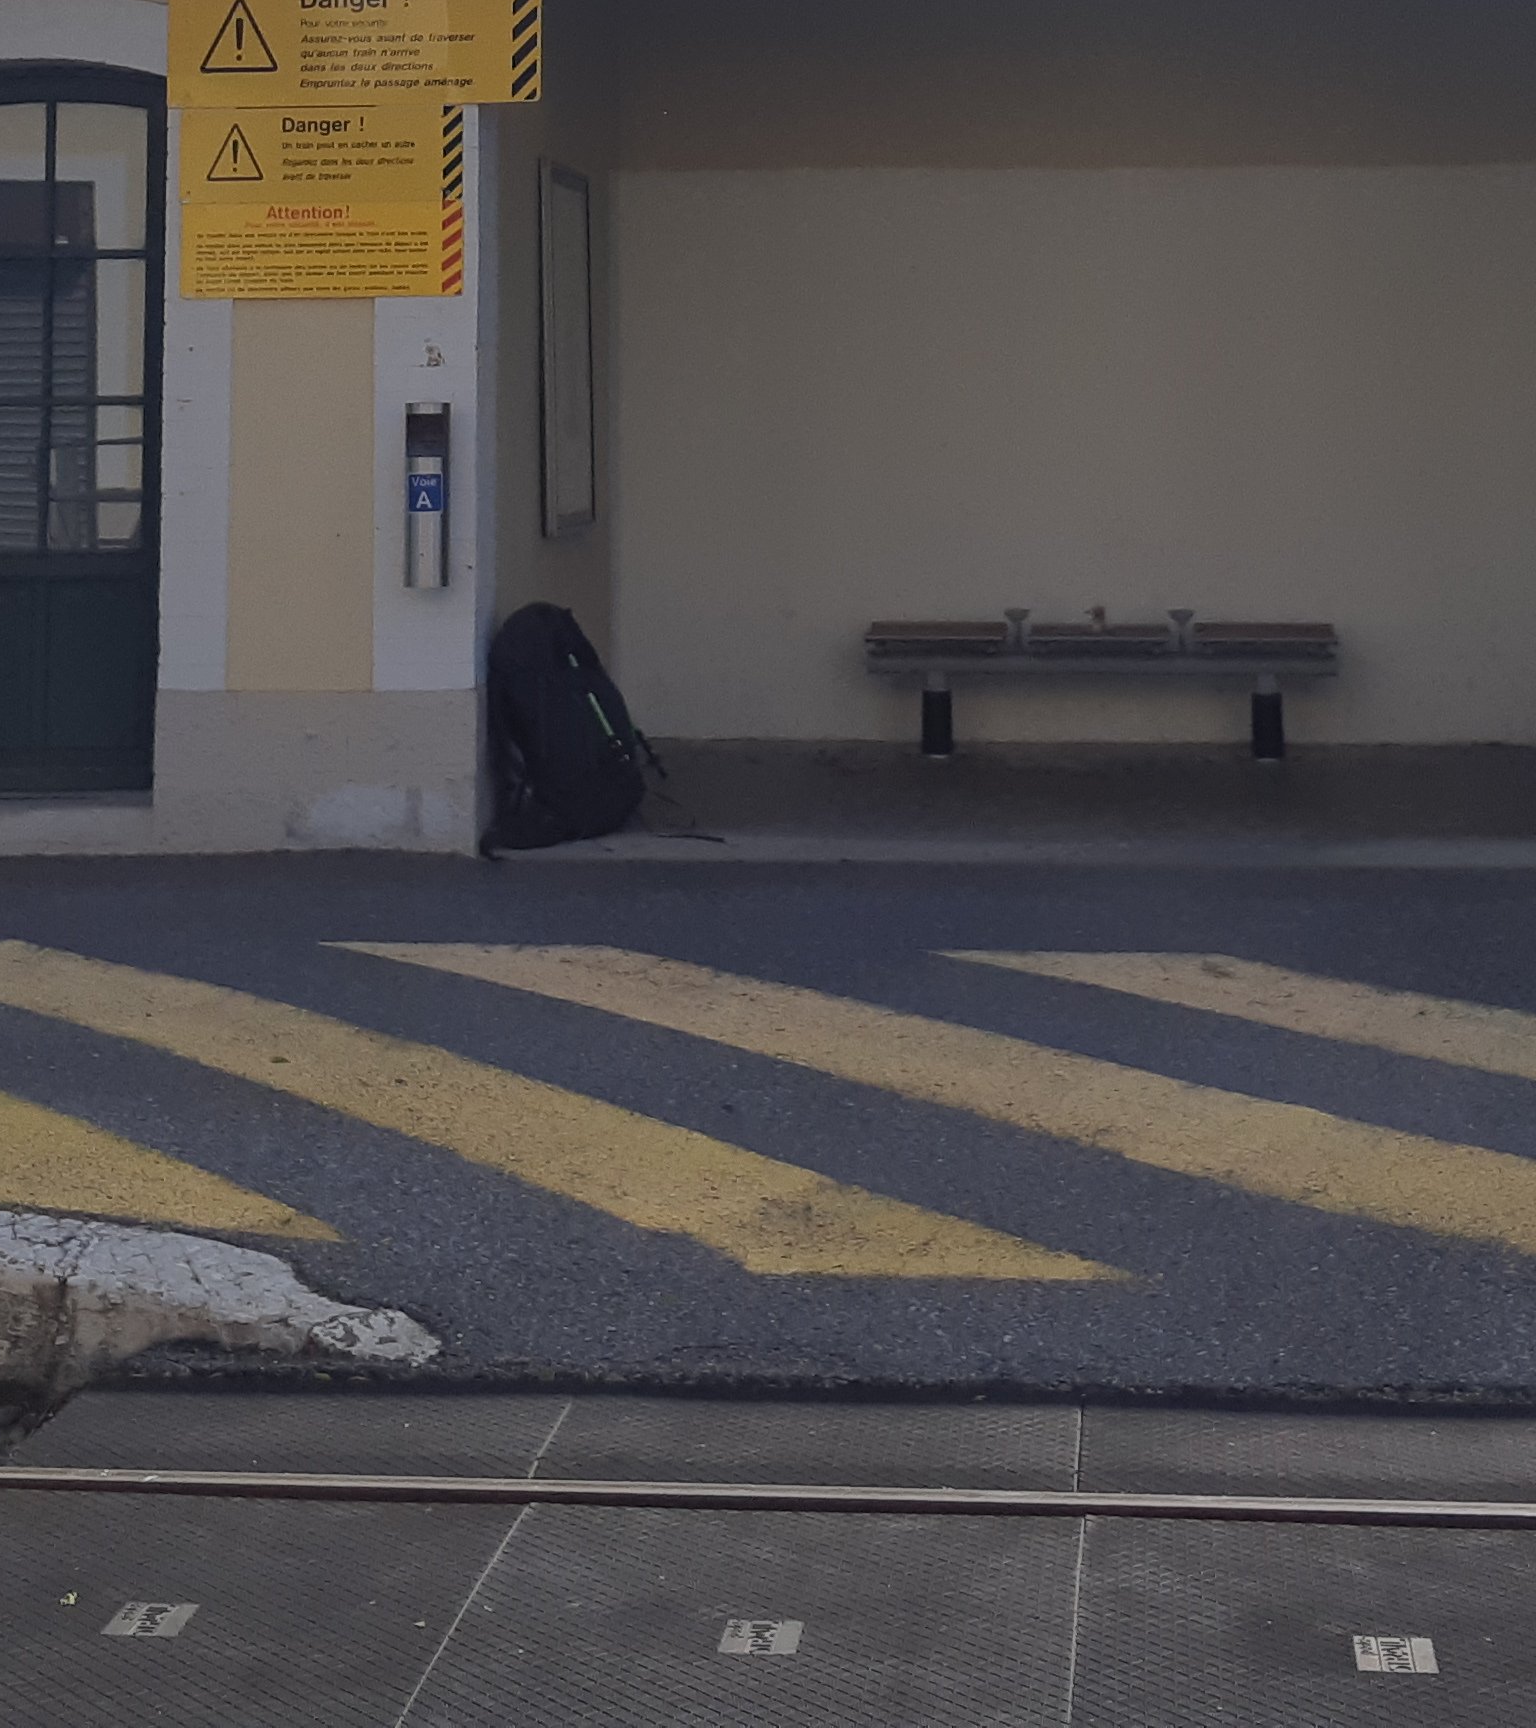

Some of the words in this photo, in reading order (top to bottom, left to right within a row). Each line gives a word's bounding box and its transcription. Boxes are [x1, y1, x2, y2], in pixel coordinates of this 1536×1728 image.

[410, 33, 423, 42] de
[429, 32, 475, 42] traverser
[353, 48, 377, 57] train
[300, 63, 326, 72] dans
[330, 62, 346, 71] les
[351, 62, 376, 71] deux
[381, 61, 434, 71] directions
[300, 79, 357, 89] Empruntez
[374, 79, 420, 89] passage
[282, 117, 351, 136] Danger
[412, 476, 438, 487] Voie
[416, 492, 433, 509] A
